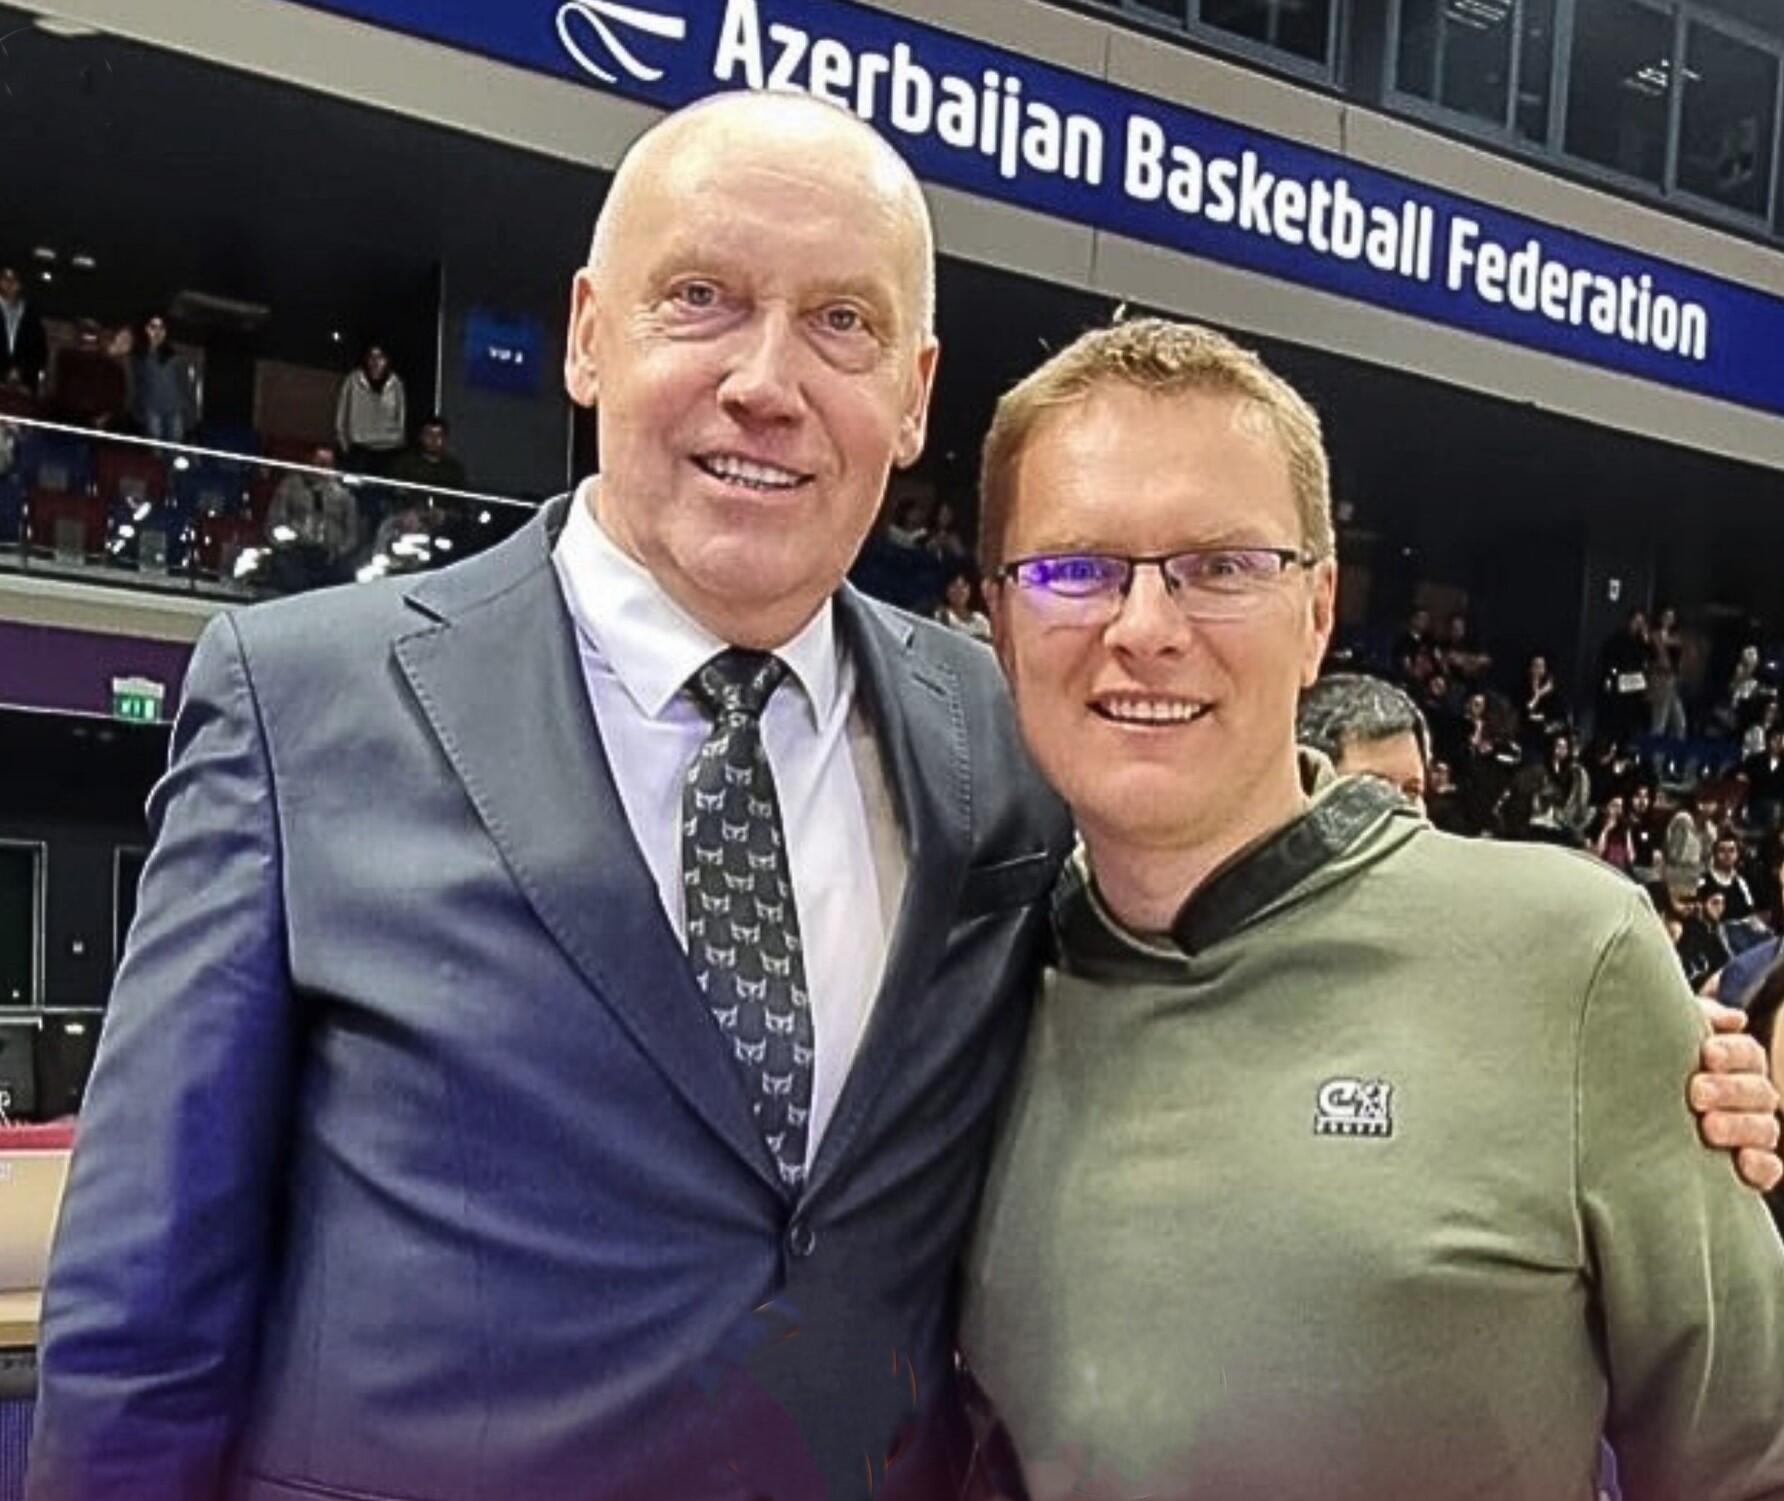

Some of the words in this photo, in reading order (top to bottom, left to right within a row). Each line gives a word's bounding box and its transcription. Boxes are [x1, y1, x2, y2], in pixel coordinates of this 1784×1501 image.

[713, 0, 1102, 185] Azerbaijan
[1124, 115, 1433, 281] Basketball
[1448, 216, 1707, 360] Federation
